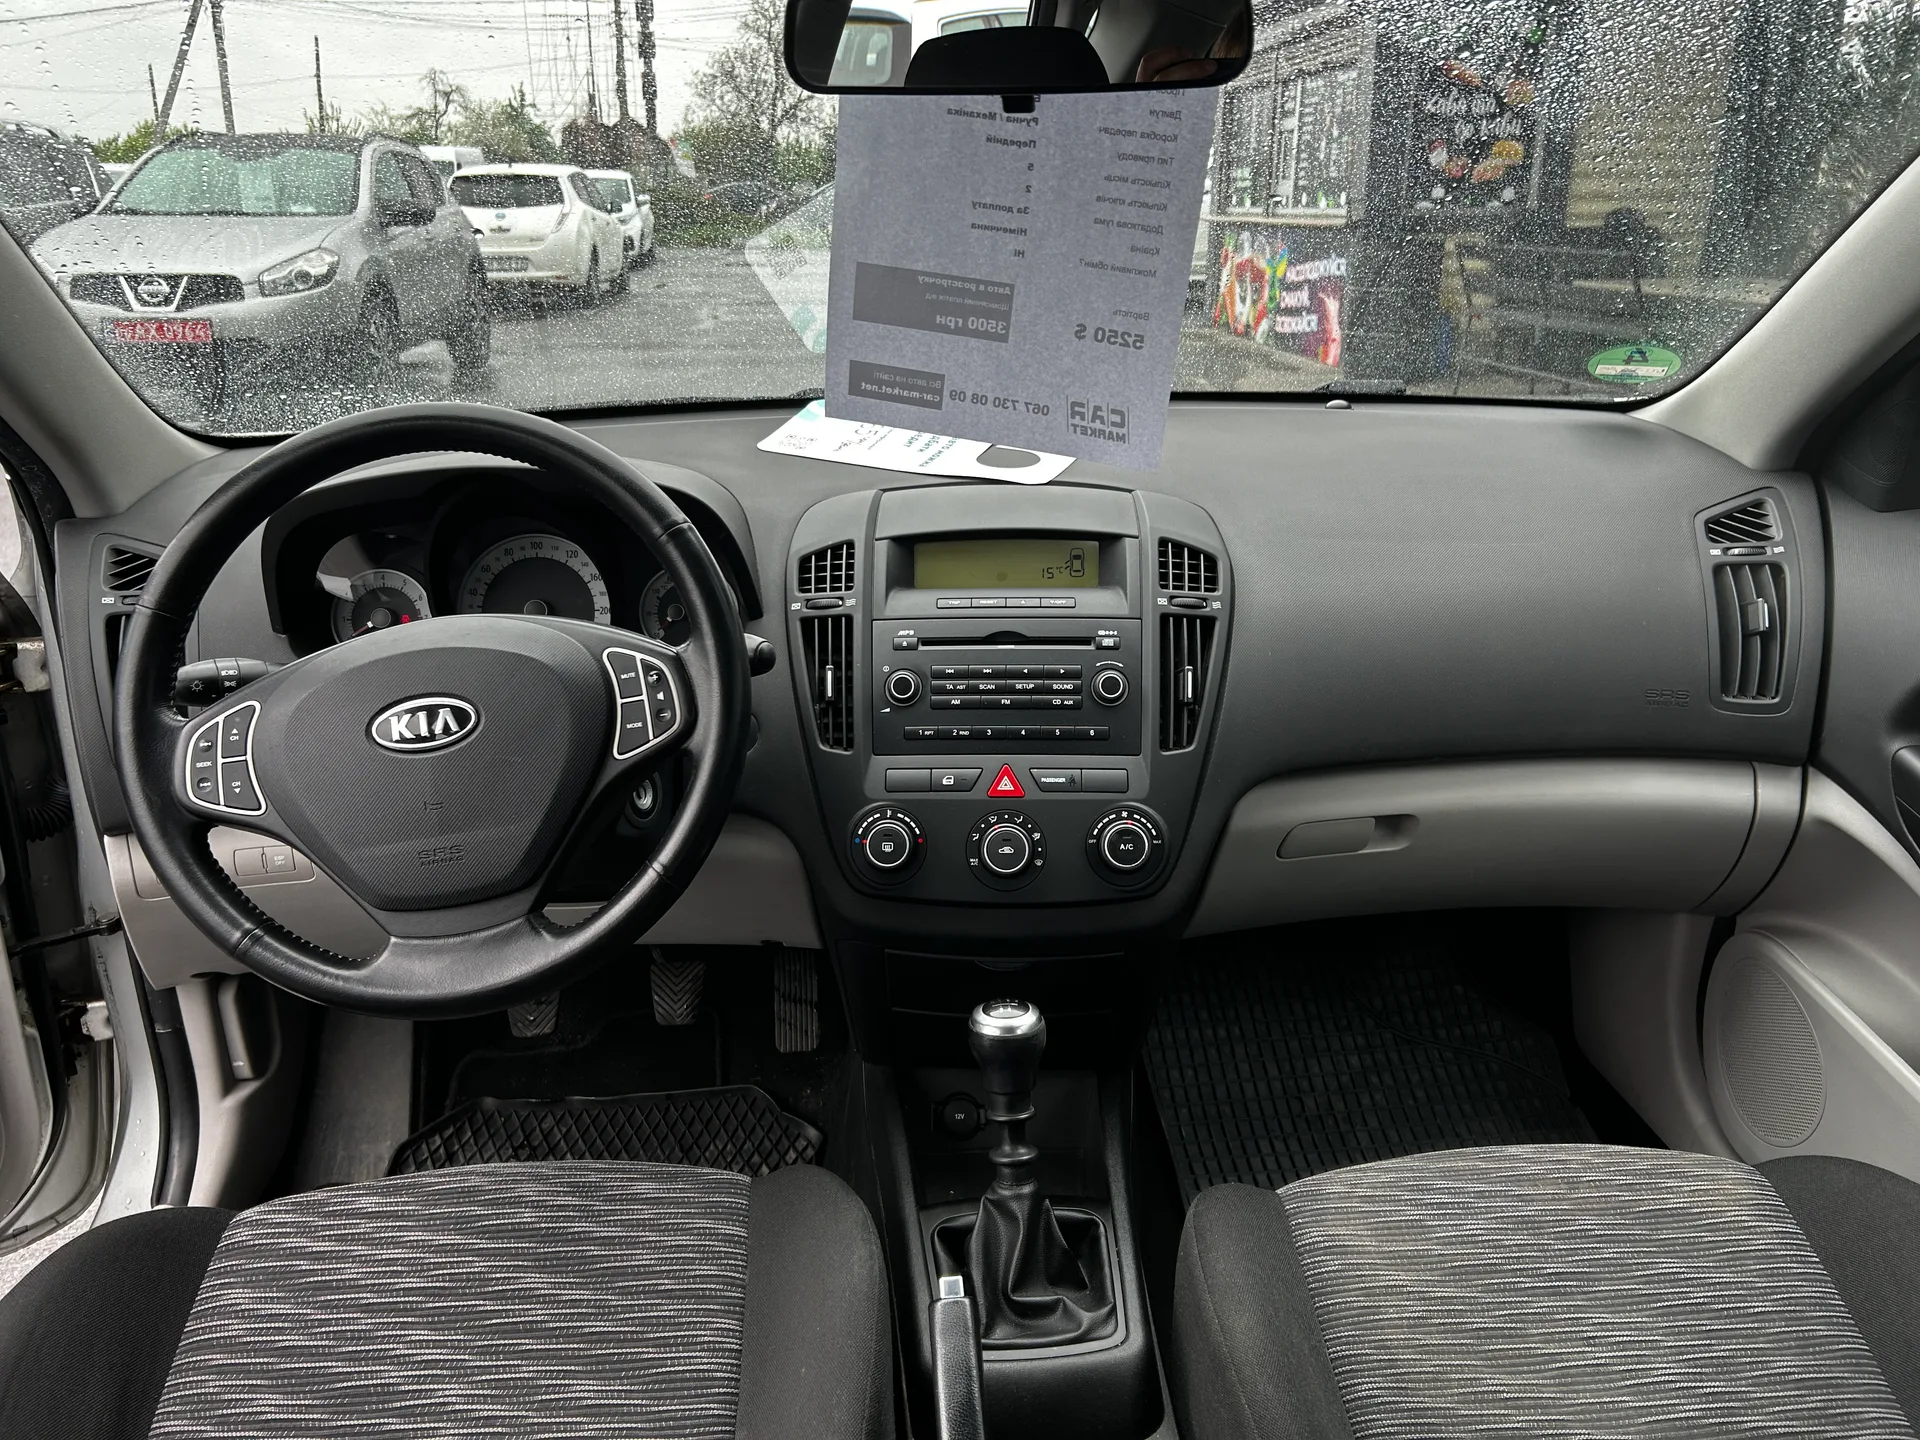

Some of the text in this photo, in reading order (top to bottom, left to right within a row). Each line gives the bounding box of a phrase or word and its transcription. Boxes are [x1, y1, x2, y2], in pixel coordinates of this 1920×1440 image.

[530, 542, 543, 550] 100
[503, 548, 514, 556] 80
[565, 550, 579, 558] 120
[481, 565, 491, 573] 60
[1042, 567, 1054, 579] 15
[590, 573, 603, 581] 160
[468, 588, 478, 596] 40
[620, 671, 636, 679] MUTE
[1645, 689, 1690, 700] SRS
[389, 708, 460, 741] KIA
[626, 721, 643, 729] MODE
[418, 845, 465, 860] SRS
